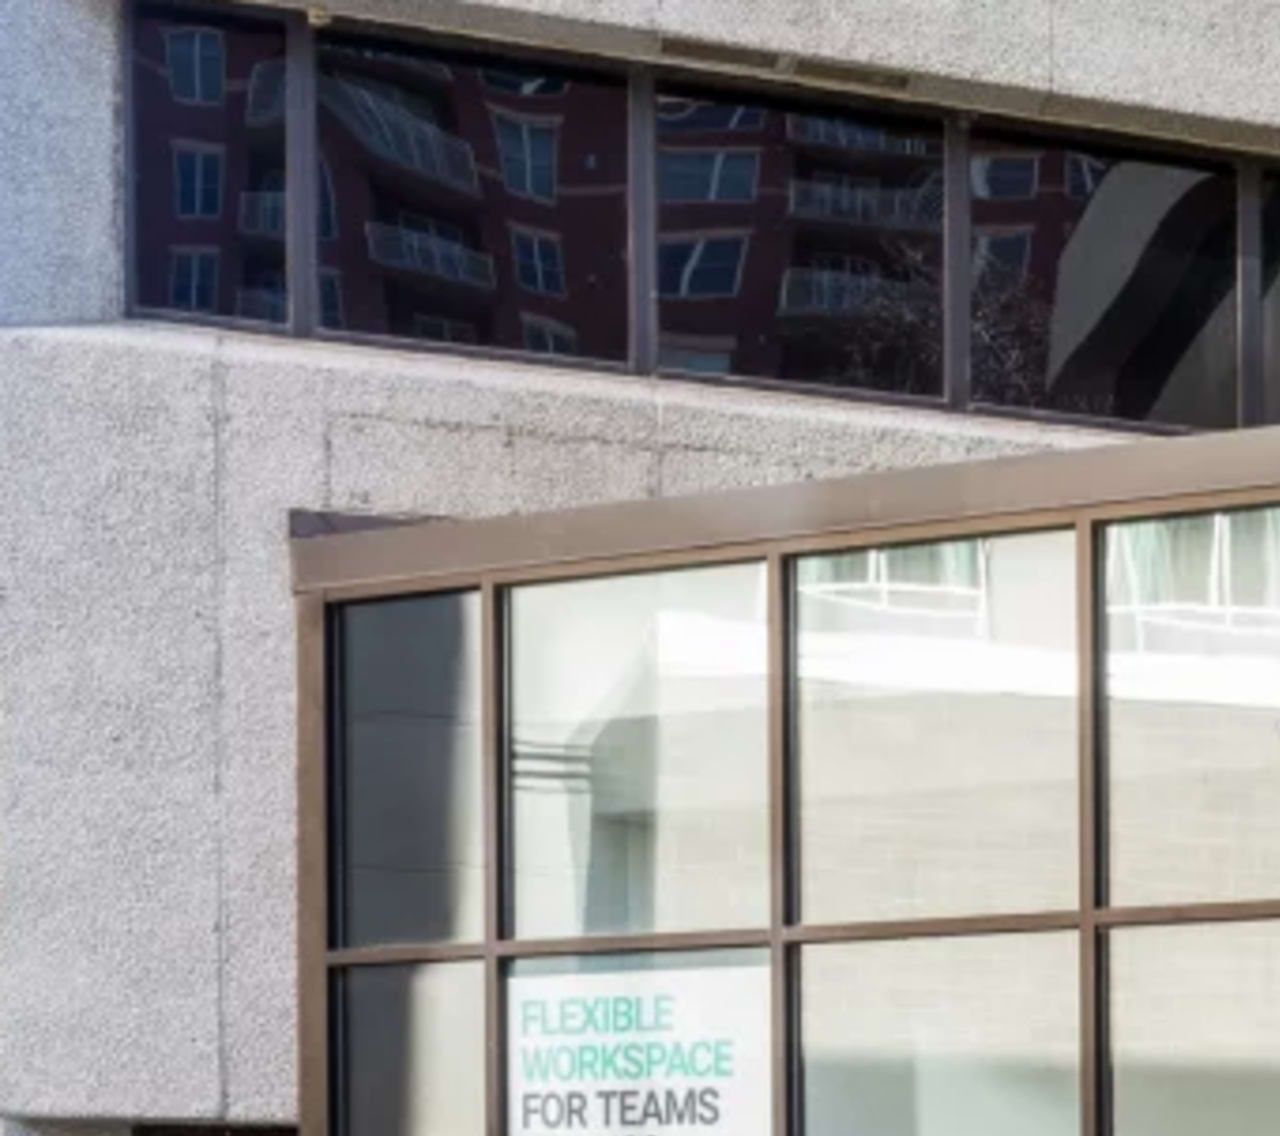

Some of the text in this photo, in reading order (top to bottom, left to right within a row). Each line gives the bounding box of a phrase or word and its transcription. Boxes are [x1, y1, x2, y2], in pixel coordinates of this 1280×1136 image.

[520, 995, 675, 1036] FLEXIBLE
[520, 1040, 735, 1083] WORKSPACE
[521, 1087, 721, 1129] FOR TEAMS
